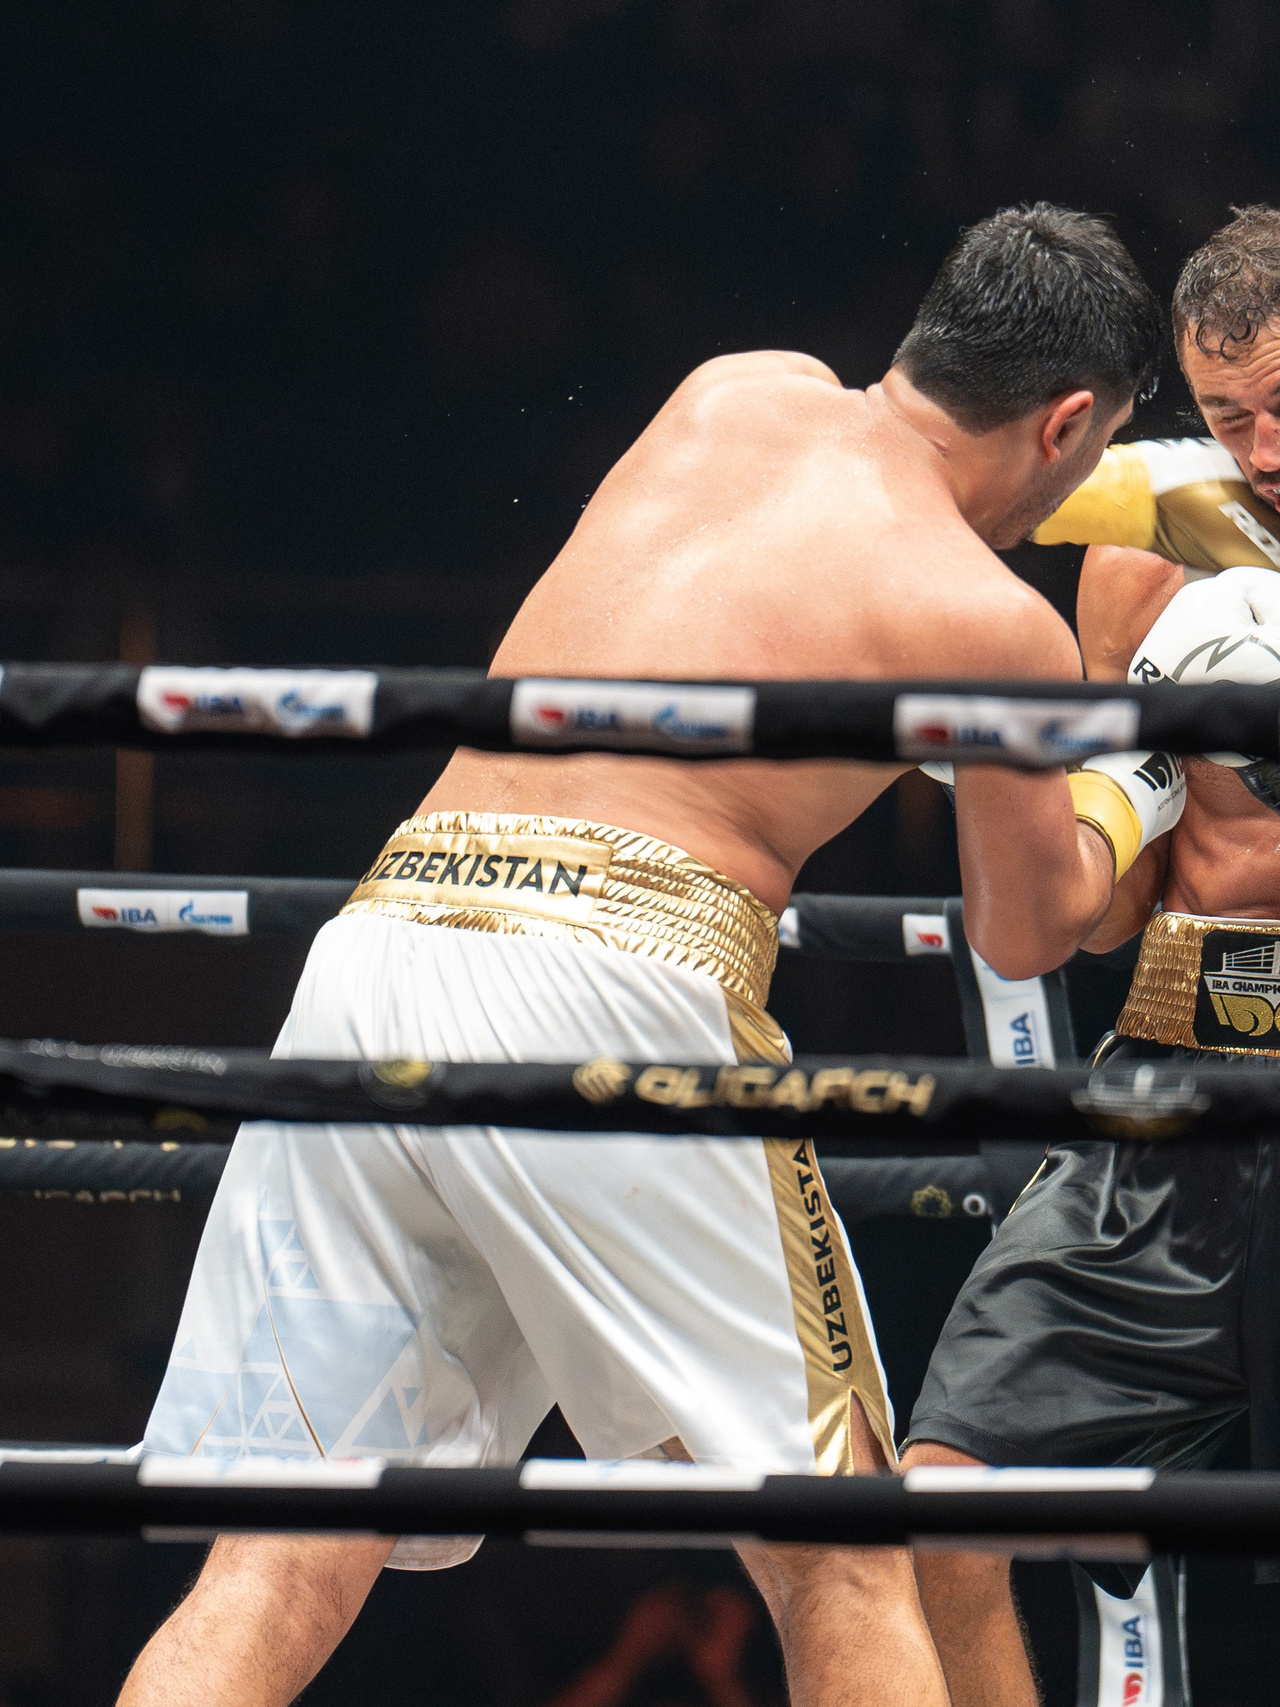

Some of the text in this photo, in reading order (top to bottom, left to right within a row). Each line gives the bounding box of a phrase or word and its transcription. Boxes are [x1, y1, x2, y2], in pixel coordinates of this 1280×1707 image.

[121, 908, 157, 923] IBA
[1212, 979, 1230, 991] IBA
[1010, 1011, 1036, 1066] IBA
[793, 1138, 853, 1372] UZBEKISTA
[1122, 1615, 1144, 1668] IBA
